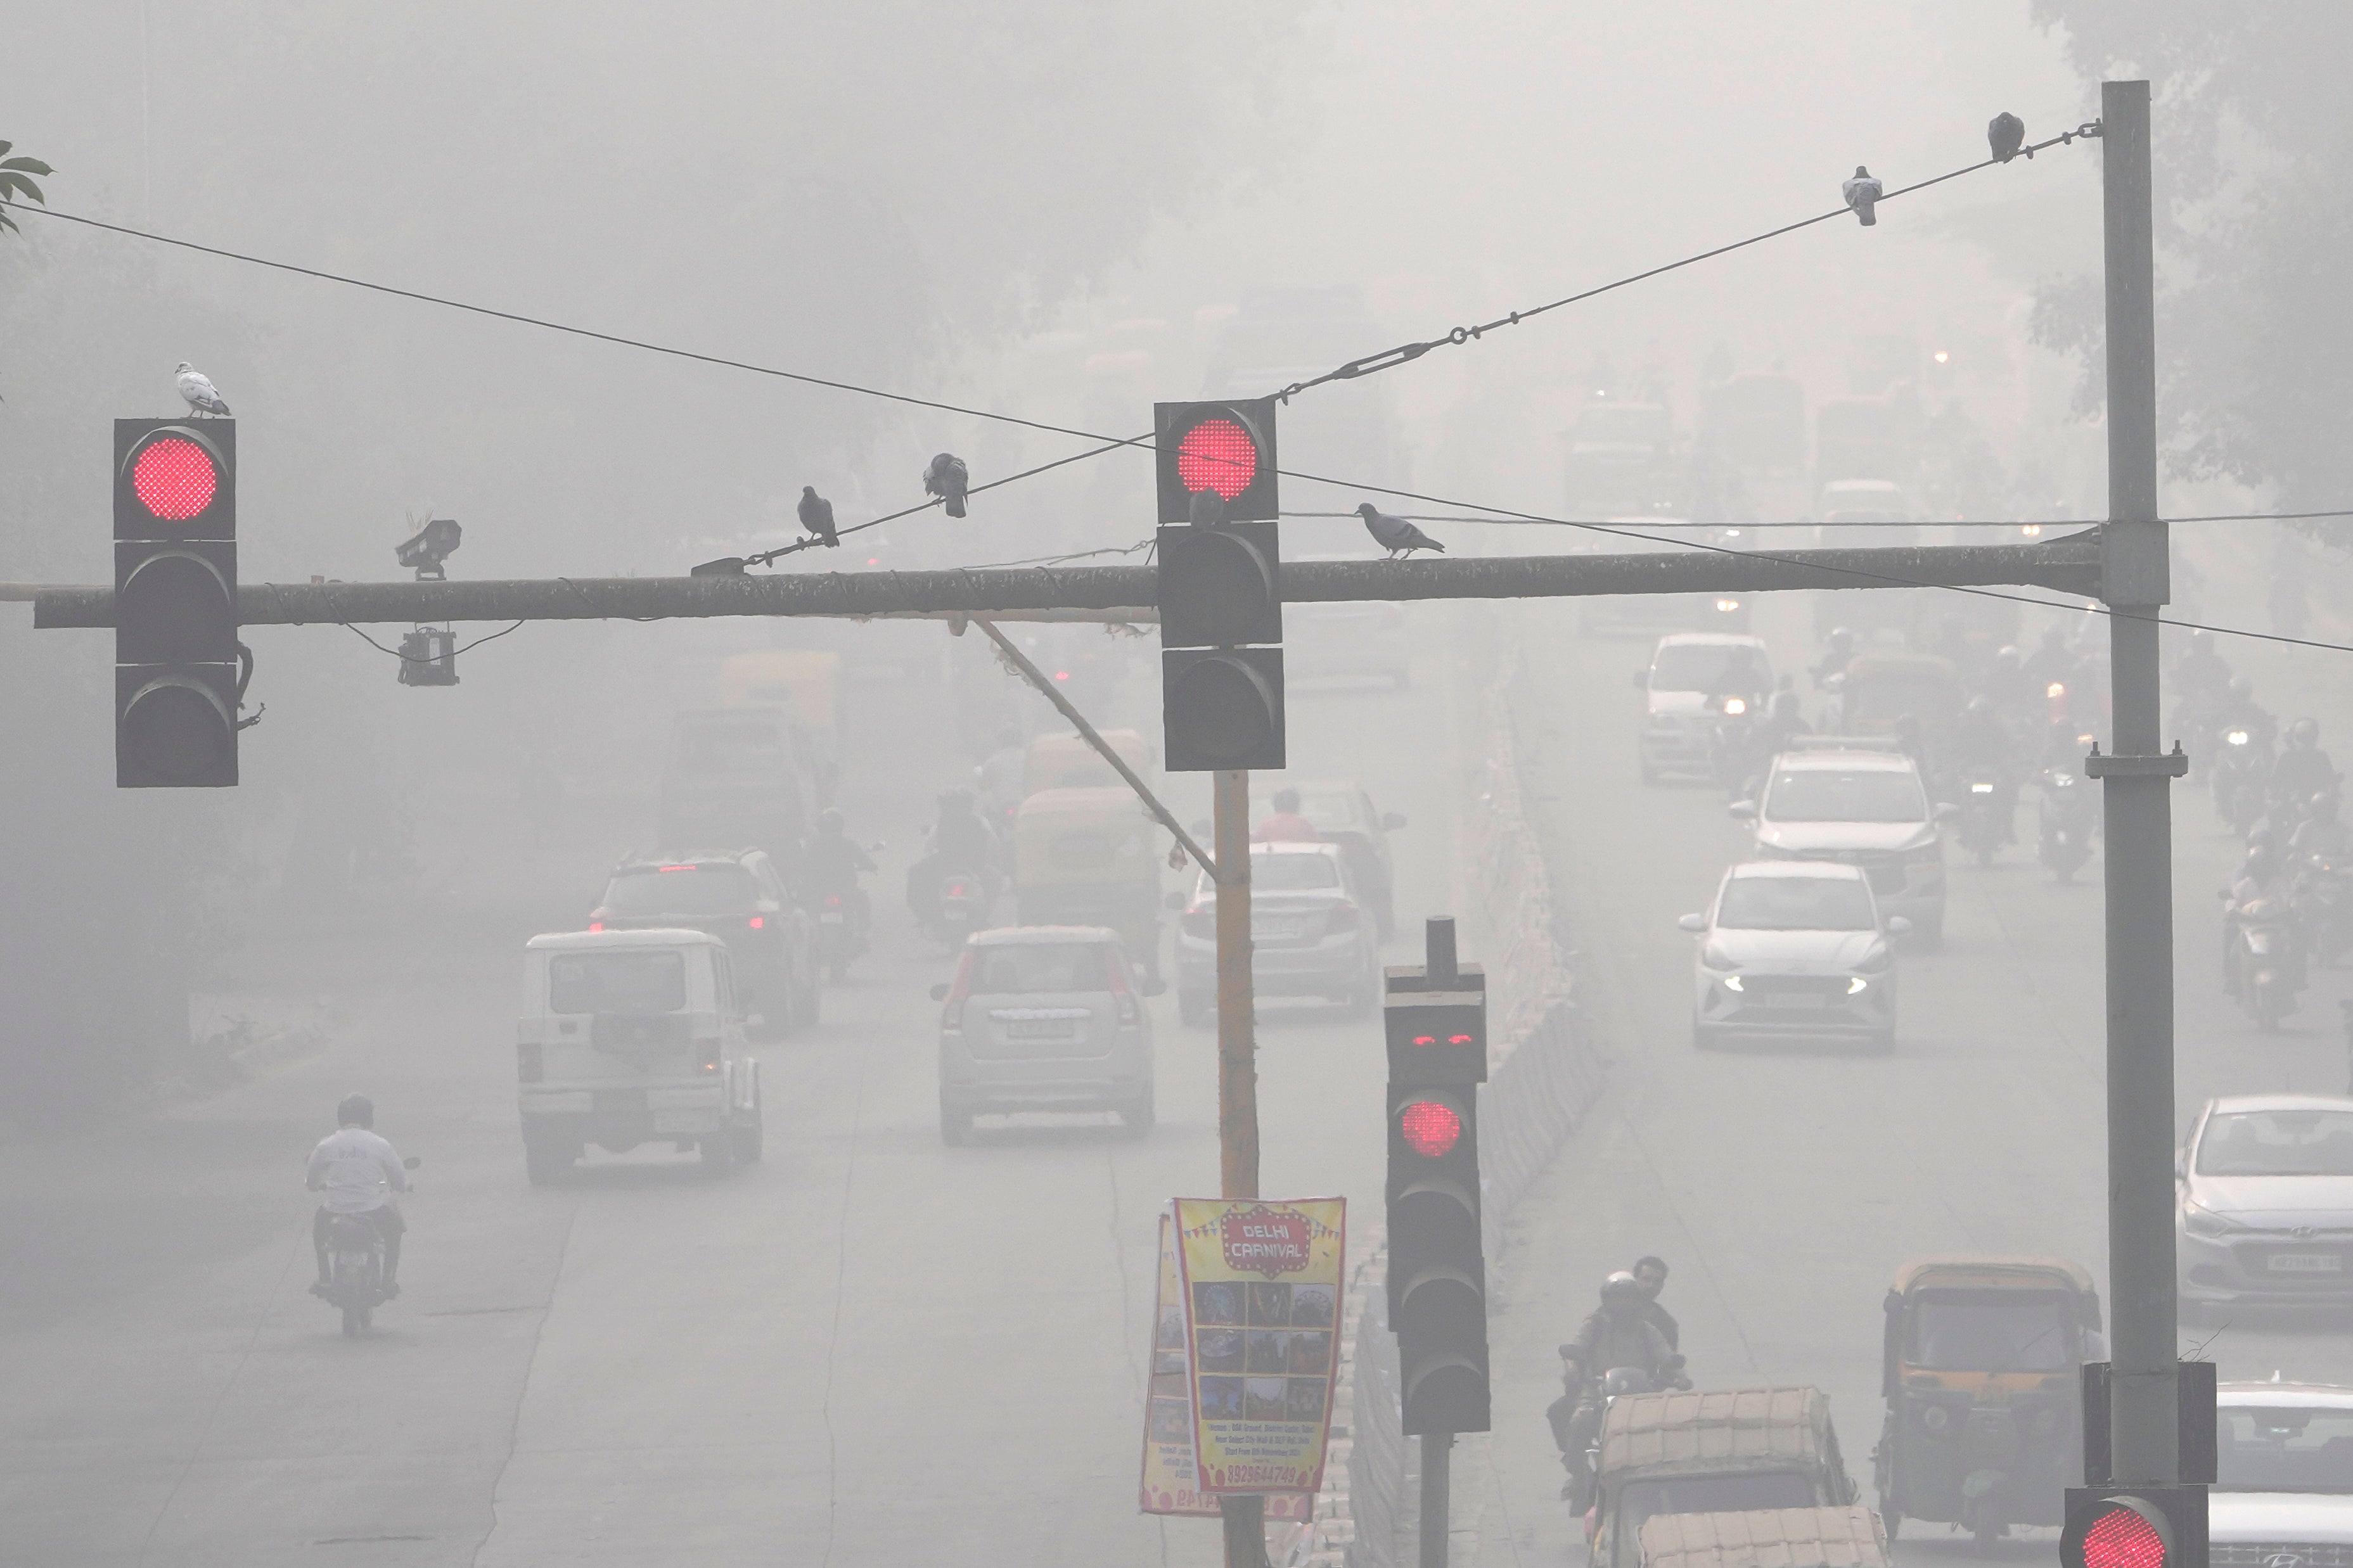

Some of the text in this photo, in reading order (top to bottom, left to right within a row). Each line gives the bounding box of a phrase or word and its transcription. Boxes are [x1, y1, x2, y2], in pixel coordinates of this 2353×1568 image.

[1243, 1225, 1290, 1240] DELHI
[1231, 1242, 1303, 1258] CARNIVAL
[1228, 1464, 1297, 1483] 8929644749
